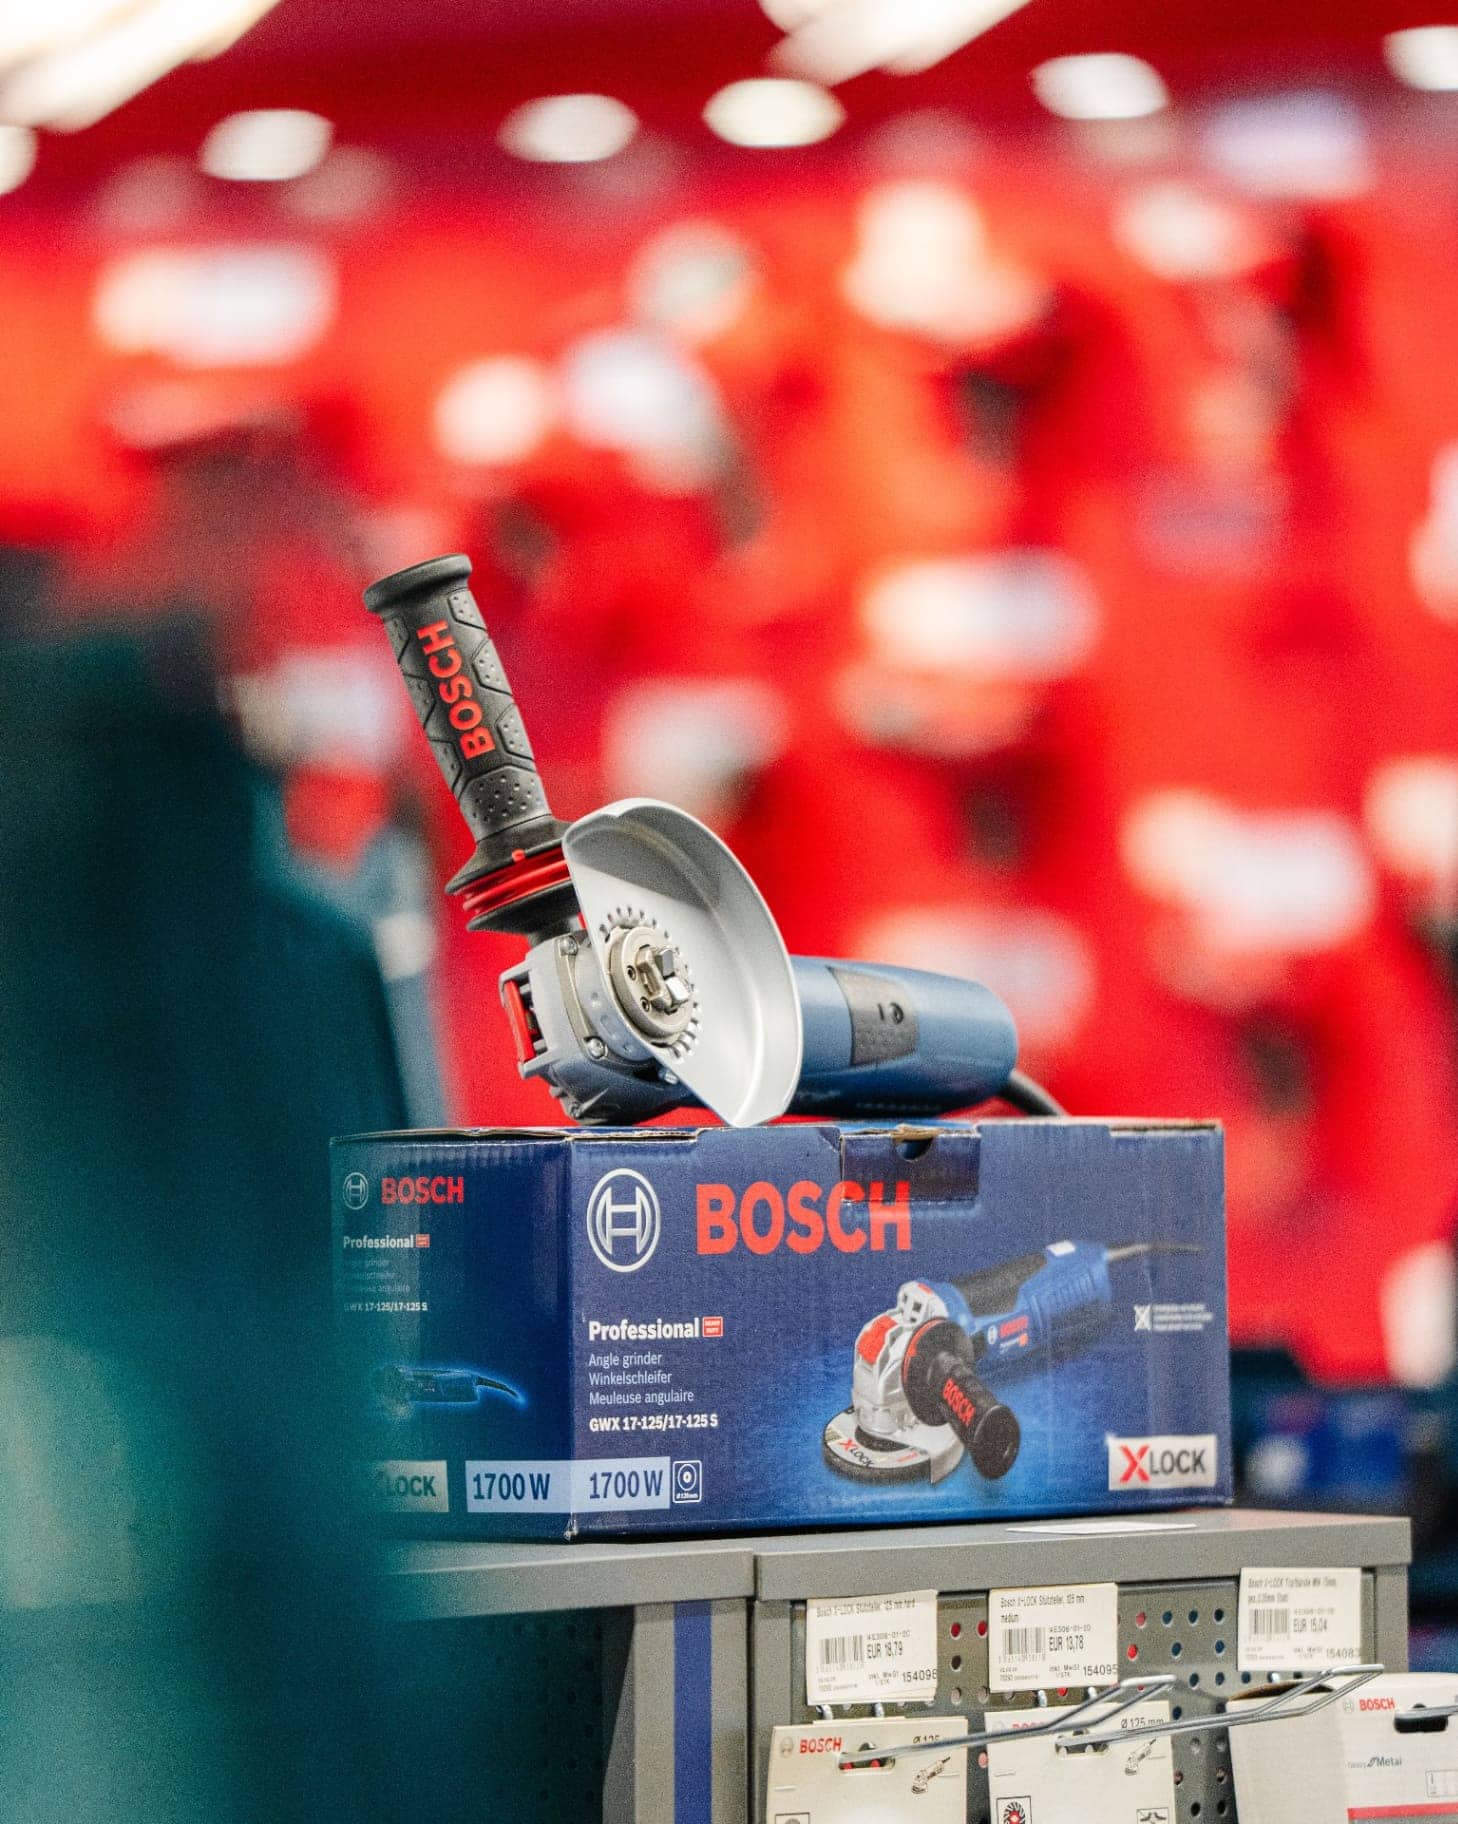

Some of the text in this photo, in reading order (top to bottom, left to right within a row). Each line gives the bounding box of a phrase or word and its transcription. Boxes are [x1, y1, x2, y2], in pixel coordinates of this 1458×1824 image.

[416, 620, 496, 760] BOSCH
[381, 1175, 464, 1205] BOSCH
[696, 1180, 911, 1255] BOSCH
[343, 1235, 414, 1249] Professional
[588, 1318, 700, 1341] Professional
[588, 1351, 662, 1369] Angle grinder
[588, 1370, 672, 1386] Winkelschleifer
[589, 1388, 694, 1406] Meuleuse angulaire
[942, 1378, 977, 1427] BOSCH
[589, 1413, 718, 1432] GWX 17-125/17-125 S
[473, 1473, 551, 1500] 1700 W
[589, 1470, 663, 1499] 1700 W
[1293, 1618, 1307, 1633] EUR
[866, 1642, 881, 1659] EUR
[1048, 1636, 1063, 1651] EUR
[1359, 1698, 1396, 1712] BOSCH
[799, 1736, 842, 1754] BOSCH
